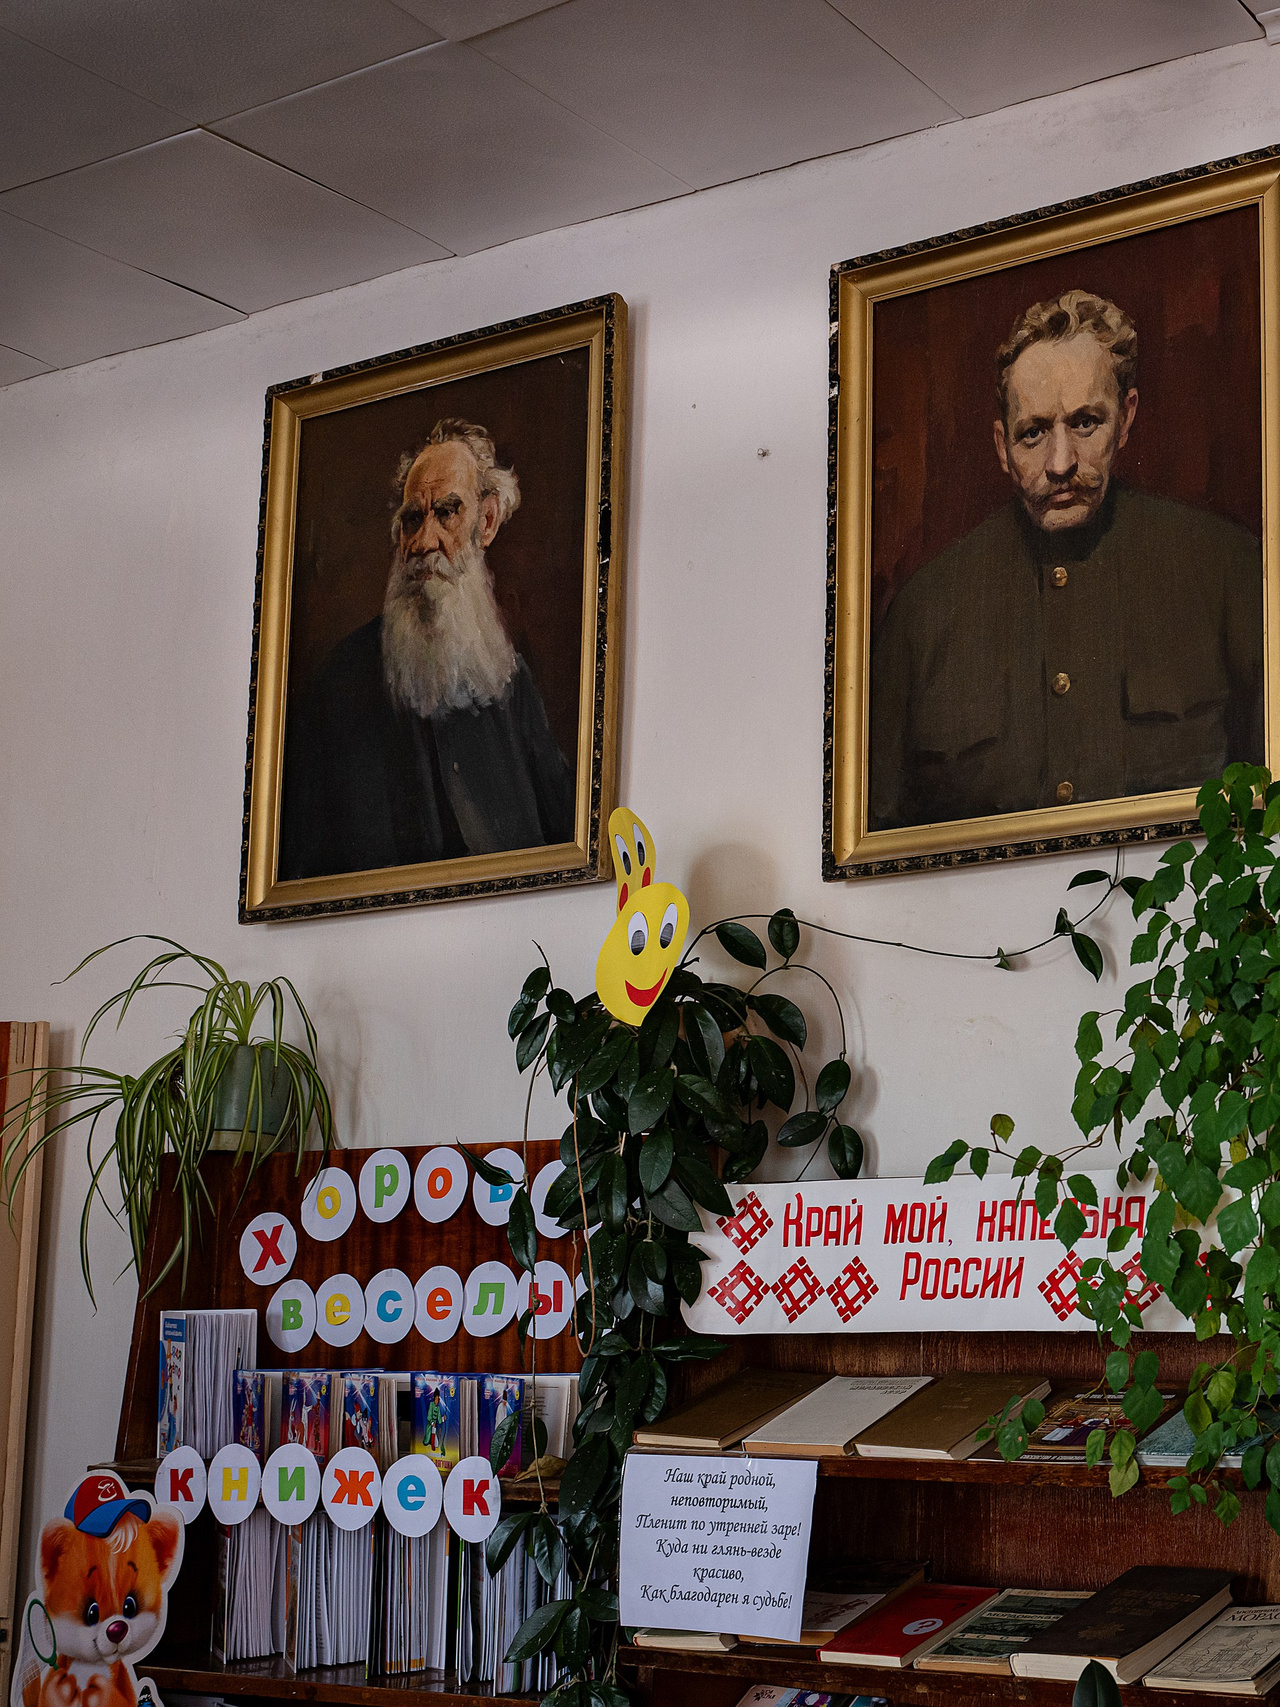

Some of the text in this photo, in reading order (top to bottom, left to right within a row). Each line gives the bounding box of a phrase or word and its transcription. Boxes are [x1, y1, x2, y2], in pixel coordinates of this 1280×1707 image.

[664, 1467, 776, 1490] Наш край родной,
[670, 1494, 769, 1513] неповторимый,
[635, 1513, 802, 1541] Пленит по утренней заре!
[656, 1538, 782, 1559] Куда ни глянь-везде
[693, 1566, 745, 1583] красиво,
[640, 1584, 793, 1611] Как благодарен я судьбе!
